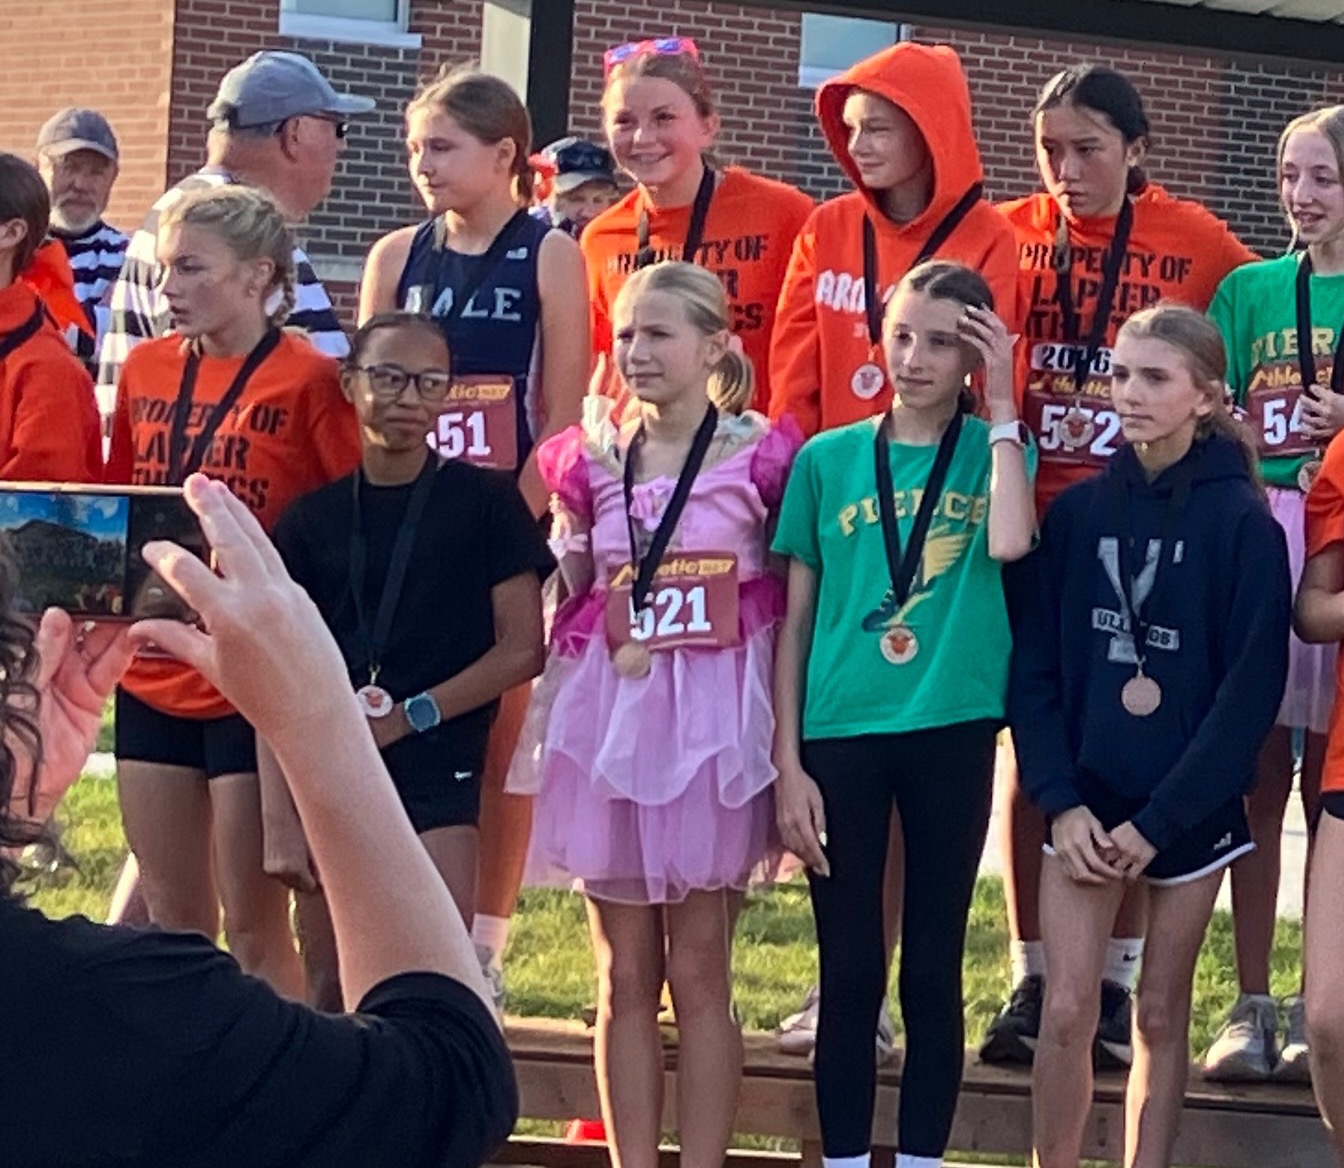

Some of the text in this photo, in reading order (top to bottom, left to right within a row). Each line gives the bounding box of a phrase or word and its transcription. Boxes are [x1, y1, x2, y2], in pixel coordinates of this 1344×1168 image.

[734, 235, 768, 262] OF
[1019, 243, 1192, 284] PRPETY OF
[251, 402, 289, 435] OF
[425, 411, 492, 458] 51
[1263, 398, 1303, 446] 54
[629, 585, 712, 642] 521
